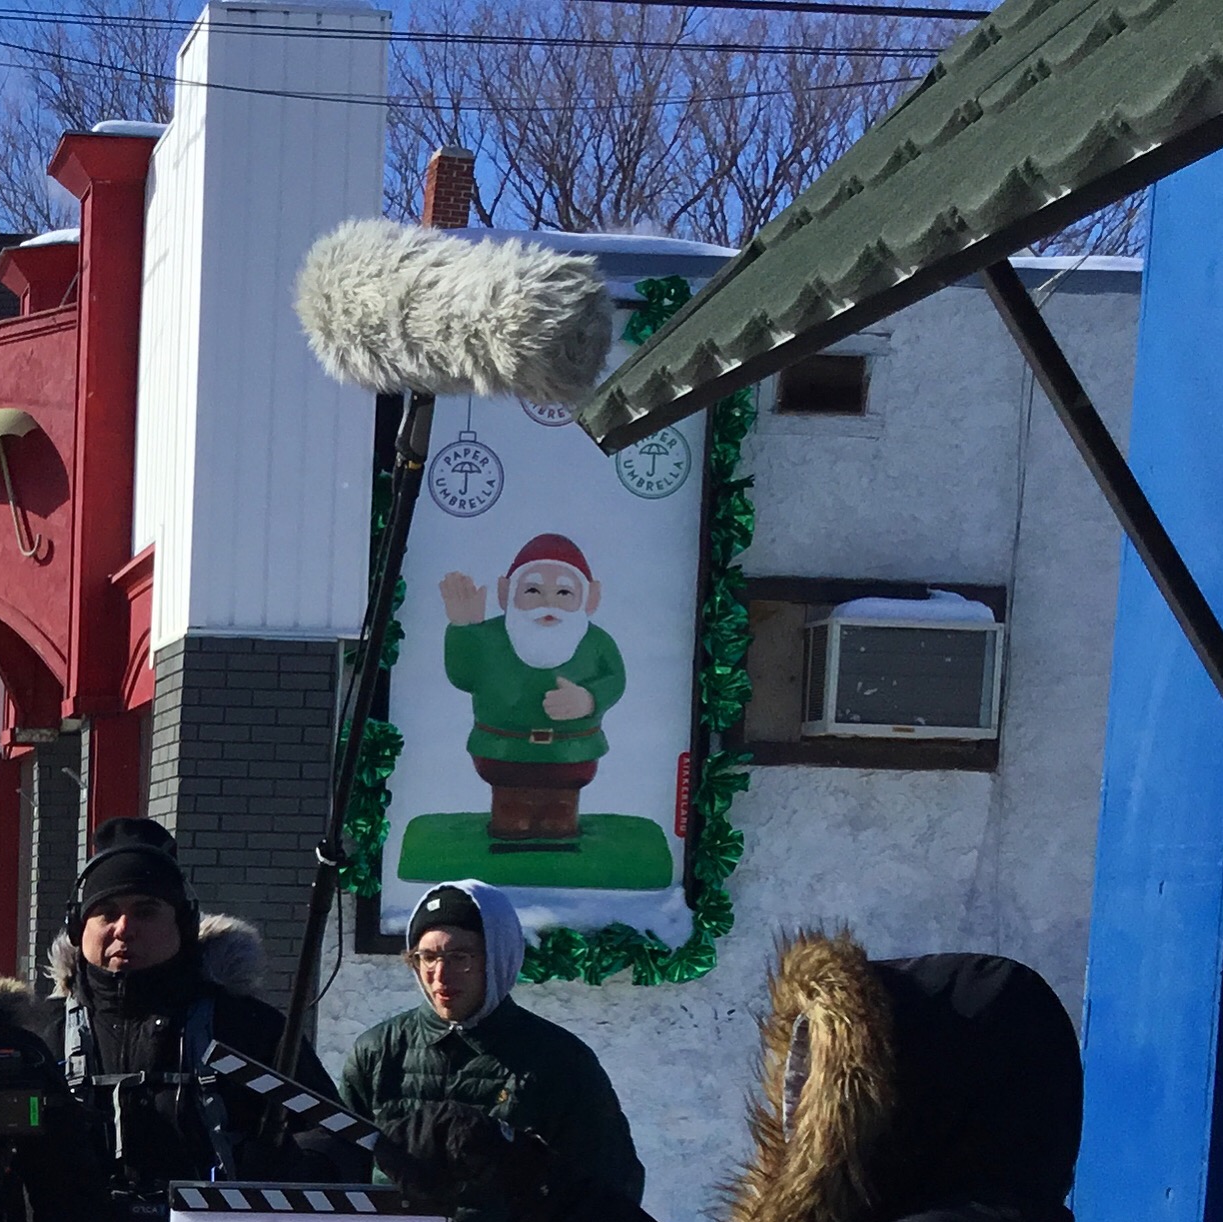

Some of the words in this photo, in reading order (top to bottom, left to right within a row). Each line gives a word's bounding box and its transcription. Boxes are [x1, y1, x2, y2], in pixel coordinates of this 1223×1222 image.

[443, 447, 490, 467] PAPER
[623, 459, 684, 491] UMBRELLA
[435, 477, 496, 510] UMBRELLA
